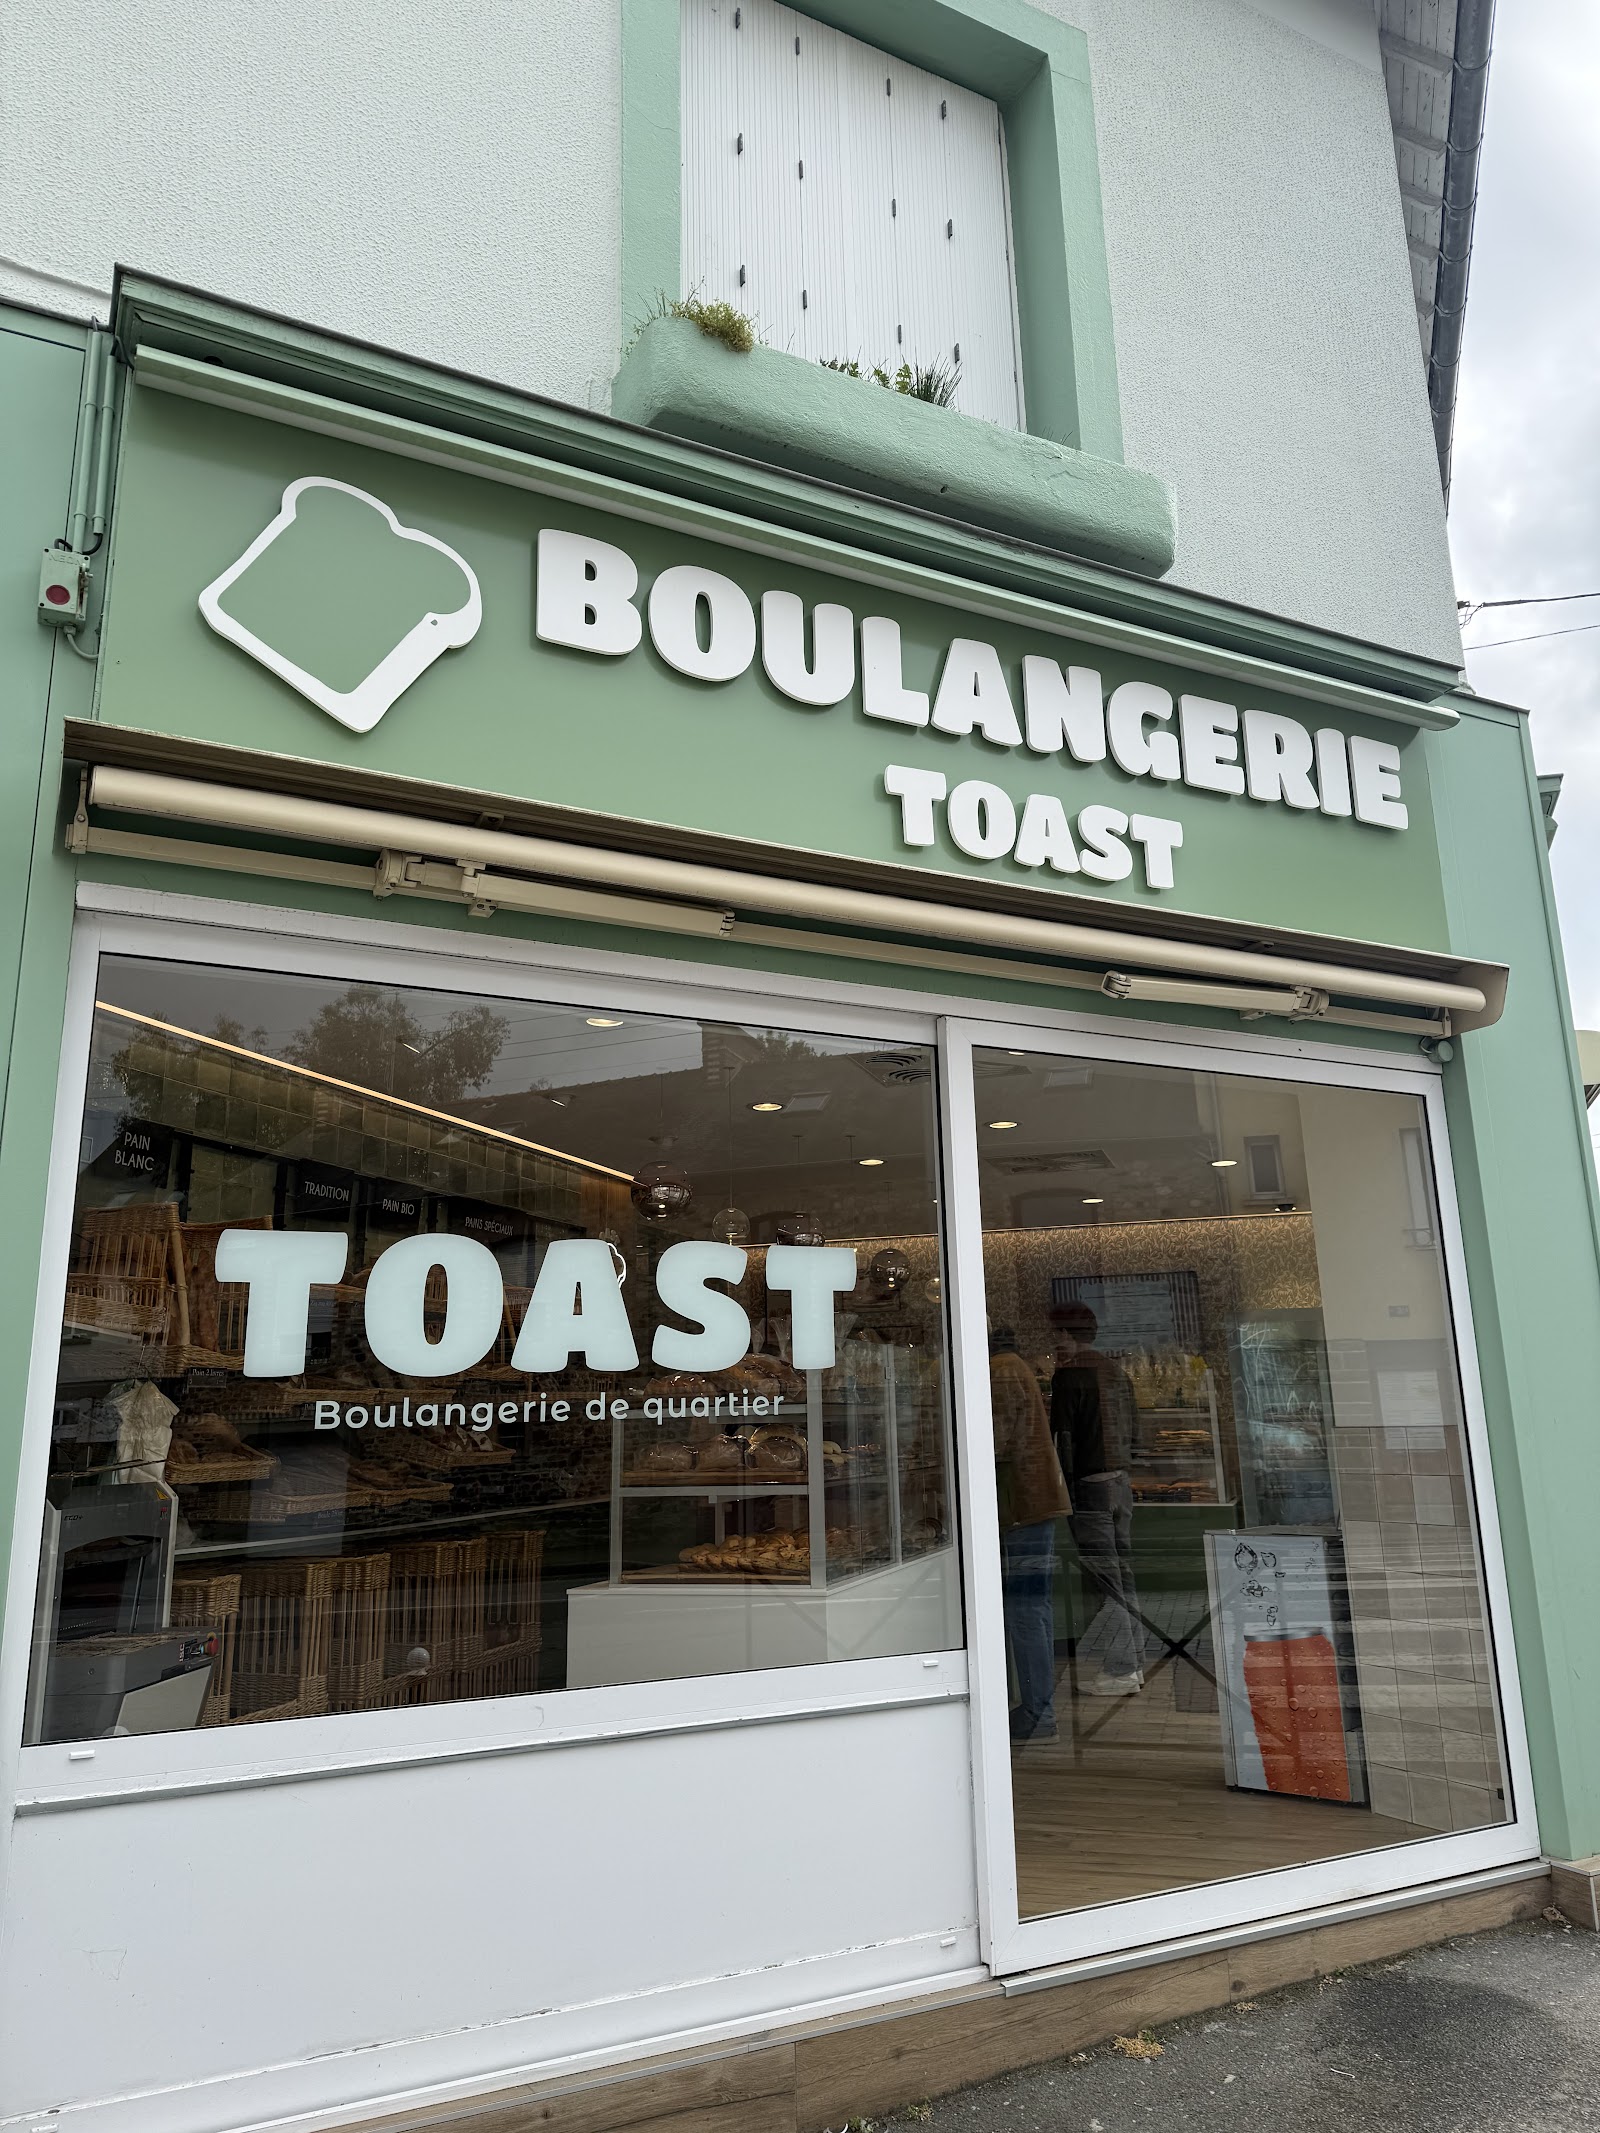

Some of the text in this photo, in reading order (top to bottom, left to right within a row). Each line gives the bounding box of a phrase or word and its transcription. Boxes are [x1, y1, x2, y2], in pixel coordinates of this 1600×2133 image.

[535, 528, 1410, 831] BOULANGERIE
[884, 764, 1185, 890] TOAST
[124, 1131, 151, 1151] PAIN
[114, 1149, 155, 1171] BLANC
[304, 1181, 350, 1202] TRADITION
[382, 1198, 416, 1216] PAIN BIO
[465, 1216, 514, 1237] PAINS SPÉCIAUX
[214, 1228, 858, 1379] TOAST
[314, 1388, 785, 1433] Boulangerie de quartier
